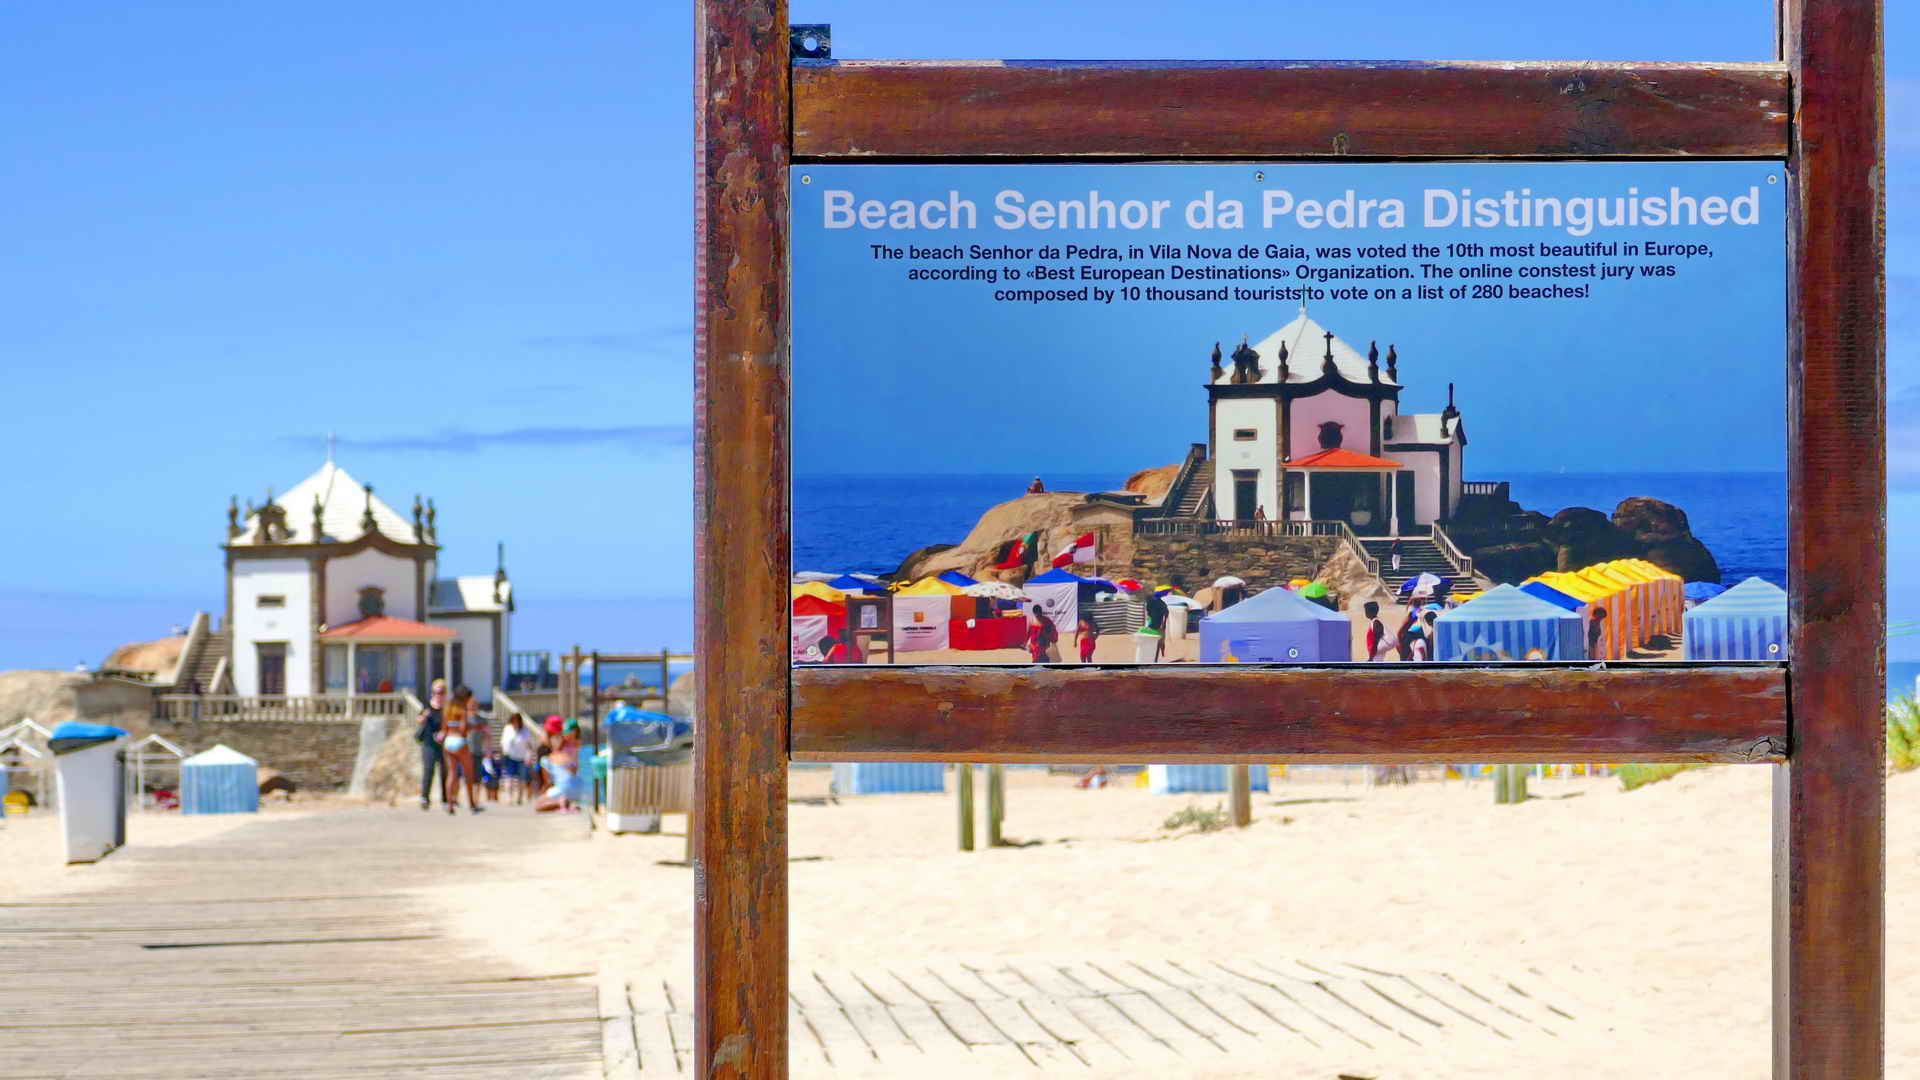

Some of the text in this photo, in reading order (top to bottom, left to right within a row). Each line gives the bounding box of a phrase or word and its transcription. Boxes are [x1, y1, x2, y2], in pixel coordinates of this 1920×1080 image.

[824, 186, 1760, 237] Beach Senhor da Pedra Distinguished
[870, 242, 1713, 262] The beach Senhor da Pedra, in Vila Nova de Gaia, was voted the 10th most beautiful in Europe,
[908, 264, 1676, 284] according to «Best European Destinations» Organization. The online constest jury was
[994, 285, 1590, 305] composed by 10 thousand tourists to vote on a list of 280 beaches!
